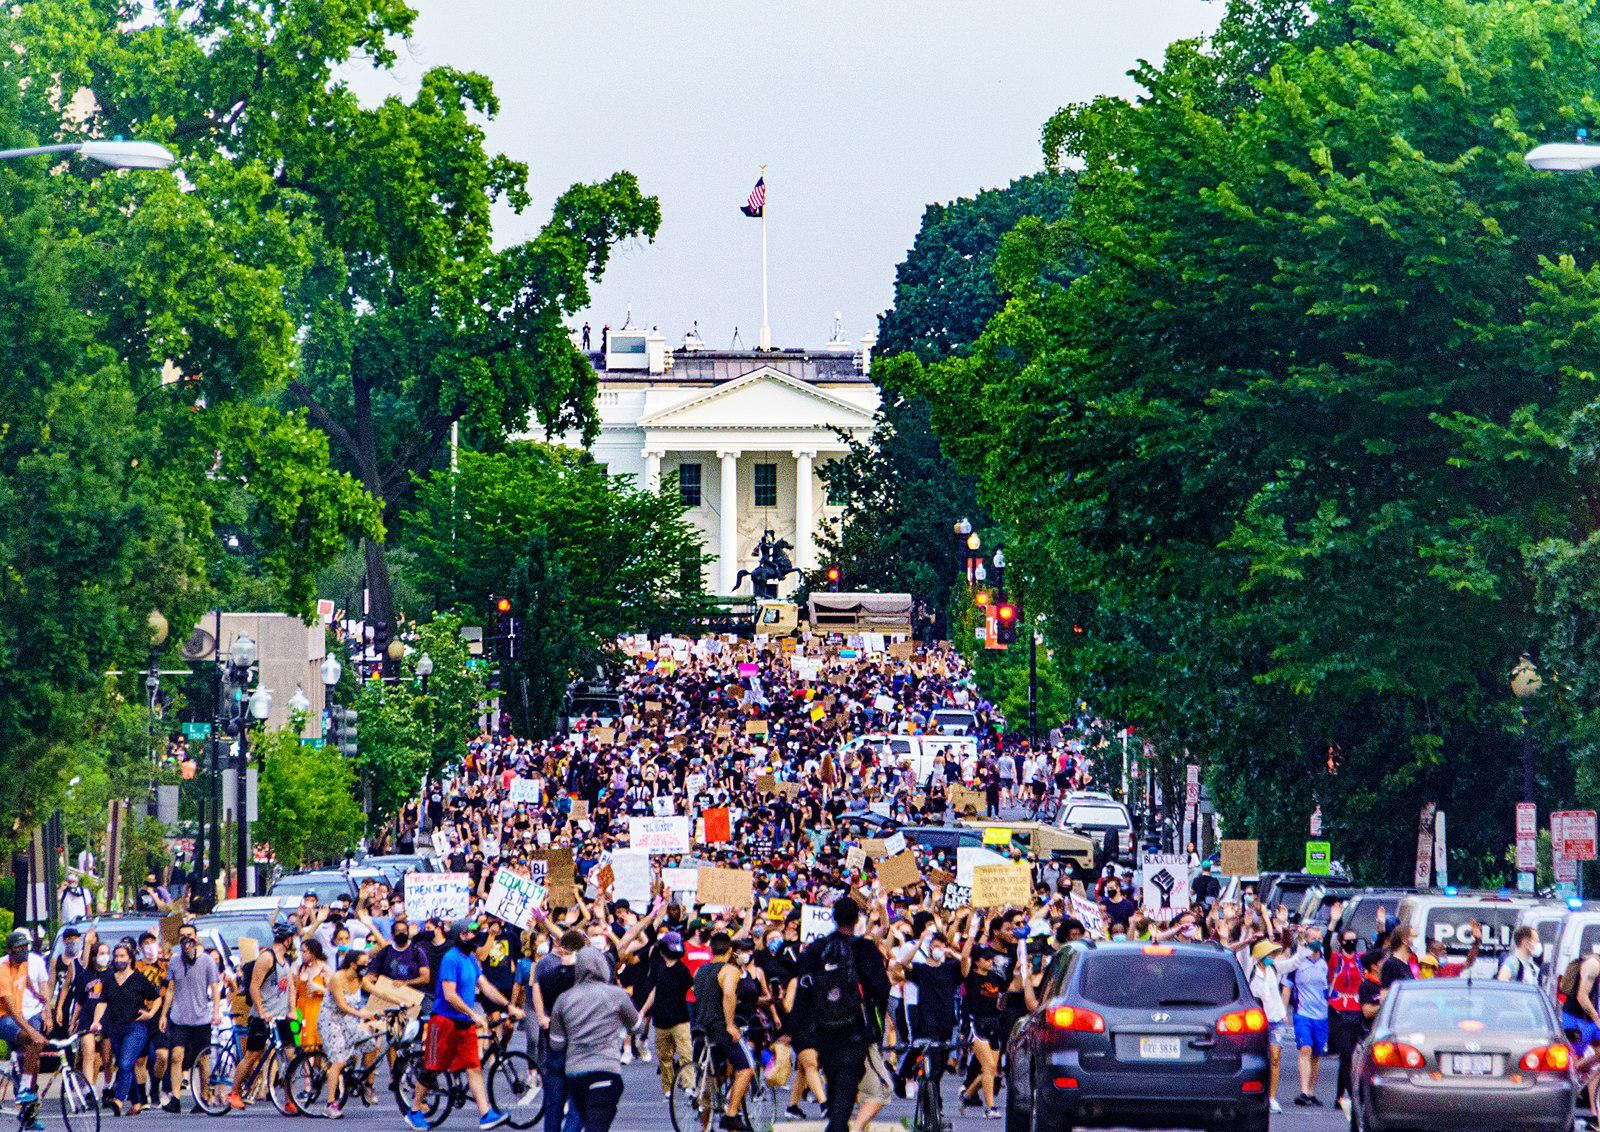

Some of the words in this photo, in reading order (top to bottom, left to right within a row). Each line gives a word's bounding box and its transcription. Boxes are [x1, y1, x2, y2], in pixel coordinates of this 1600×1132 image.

[499, 871, 544, 900] EQUALITY
[947, 883, 971, 897] BLAC
[496, 899, 524, 925] KEY
[1433, 922, 1510, 945] POLI
